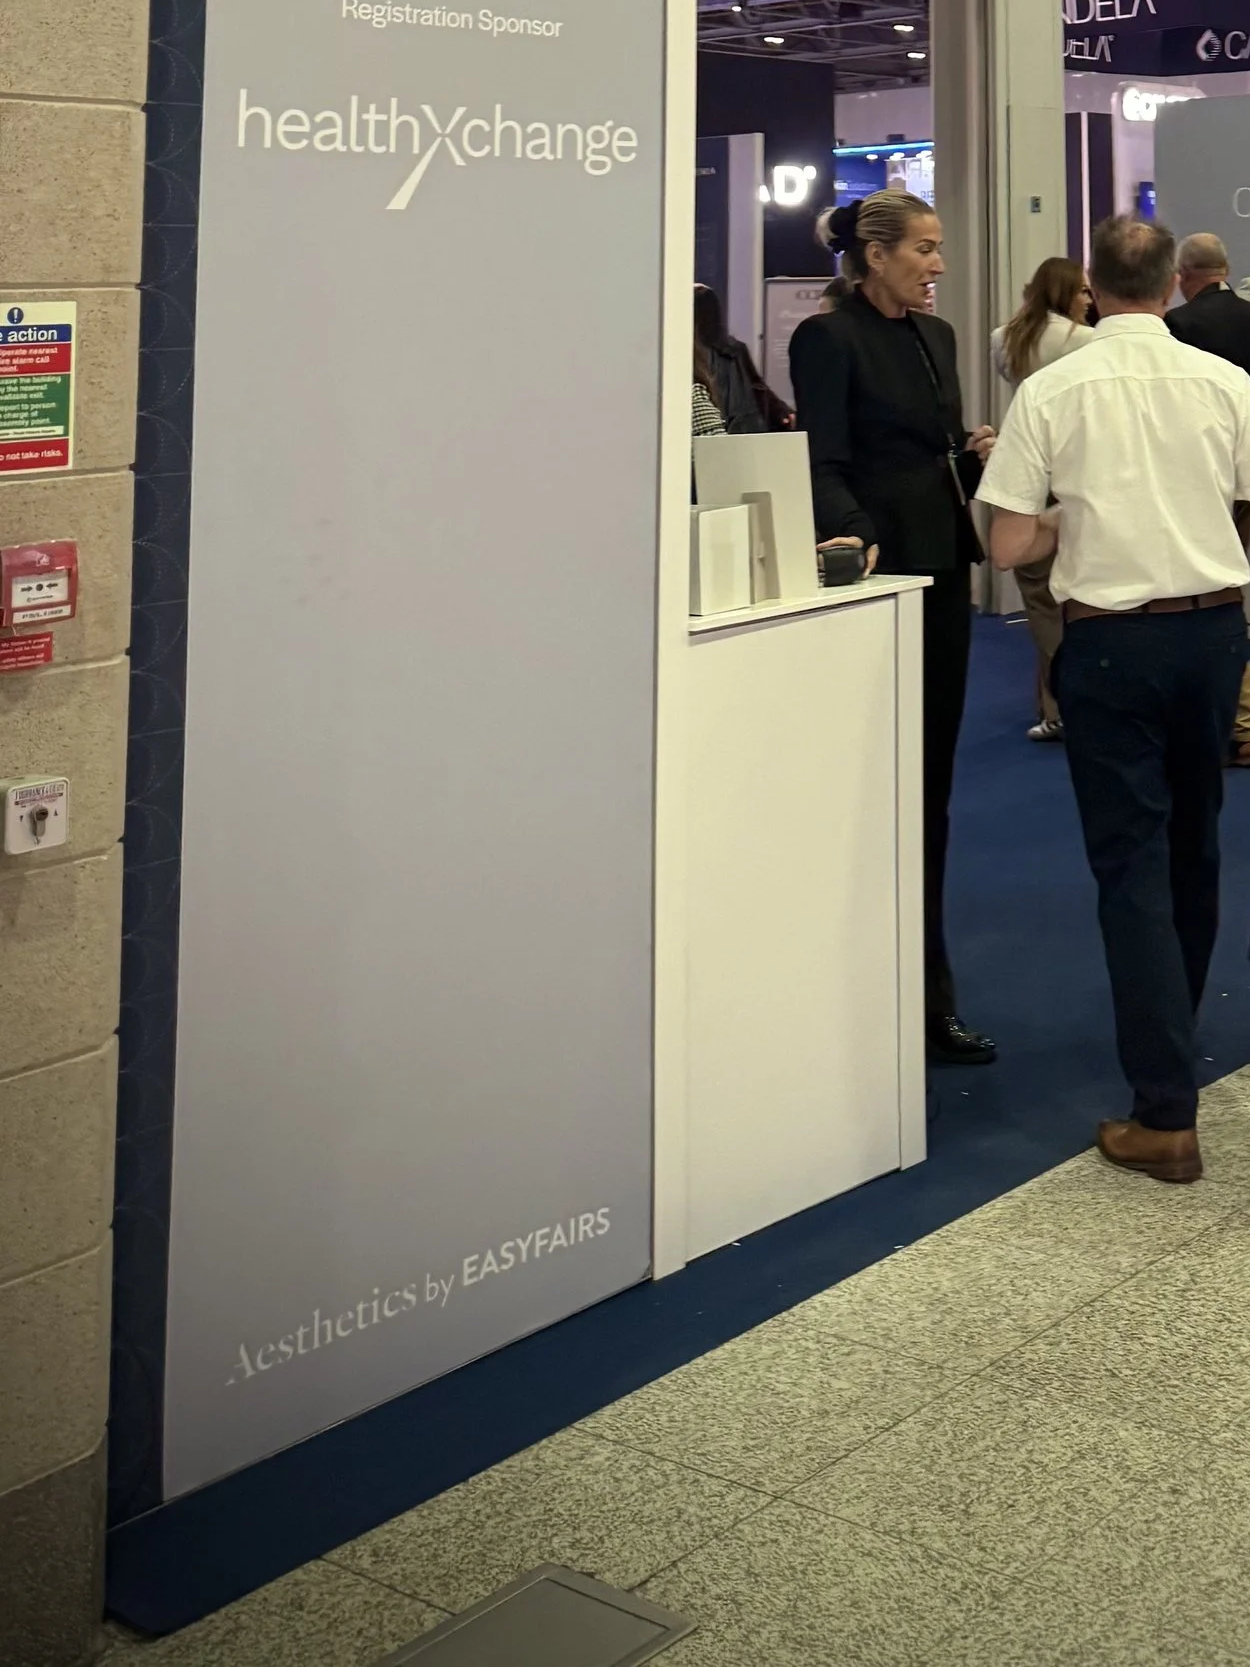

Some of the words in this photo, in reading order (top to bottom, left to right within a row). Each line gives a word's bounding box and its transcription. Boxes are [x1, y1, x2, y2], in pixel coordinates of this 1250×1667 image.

[478, 9, 563, 37] Sponsor
[236, 88, 638, 210] healthXchange
[8, 327, 58, 343] action
[224, 1282, 418, 1387] Aesthetics
[424, 1273, 455, 1308] by
[461, 1207, 611, 1288] EASYFAIRS
